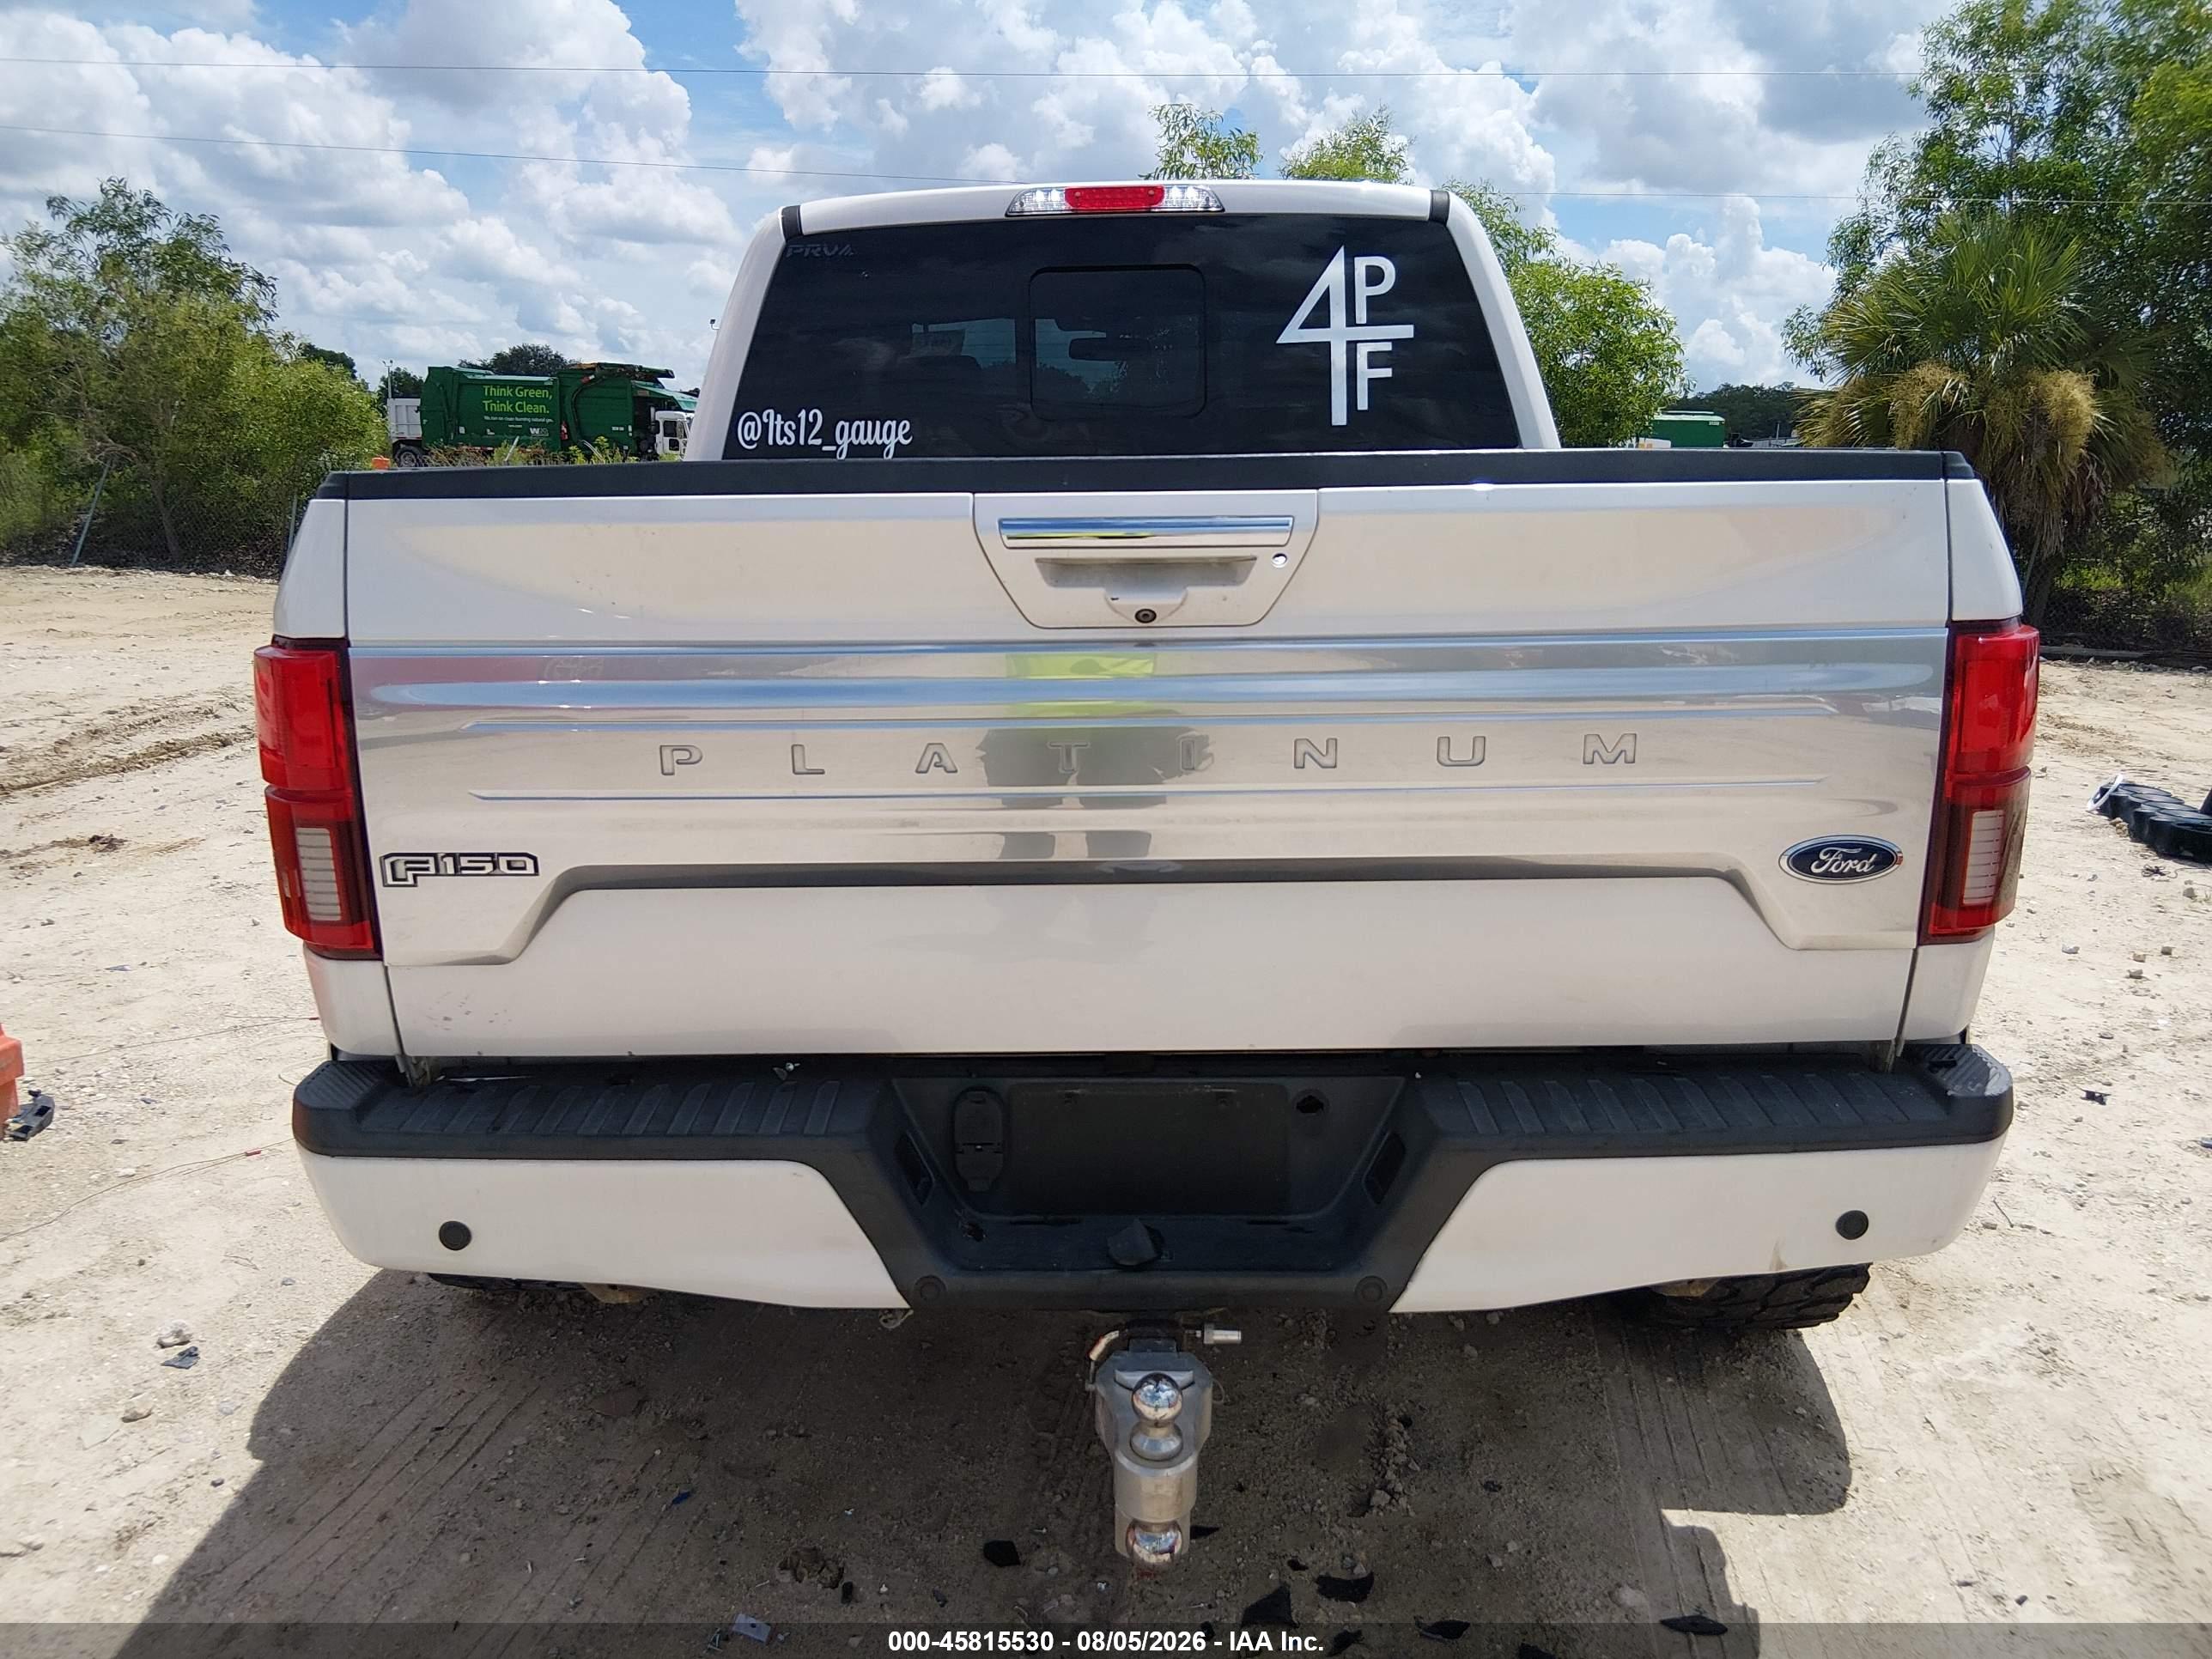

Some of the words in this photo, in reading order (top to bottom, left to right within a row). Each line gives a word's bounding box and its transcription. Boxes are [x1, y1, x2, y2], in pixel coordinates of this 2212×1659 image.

[483, 385, 513, 397] Think
[515, 386, 552, 400] Green,
[483, 400, 514, 412] Think
[515, 401, 550, 414] Clean.
[659, 732, 1638, 776] PLATINUM
[1810, 847, 1878, 873] Ford
